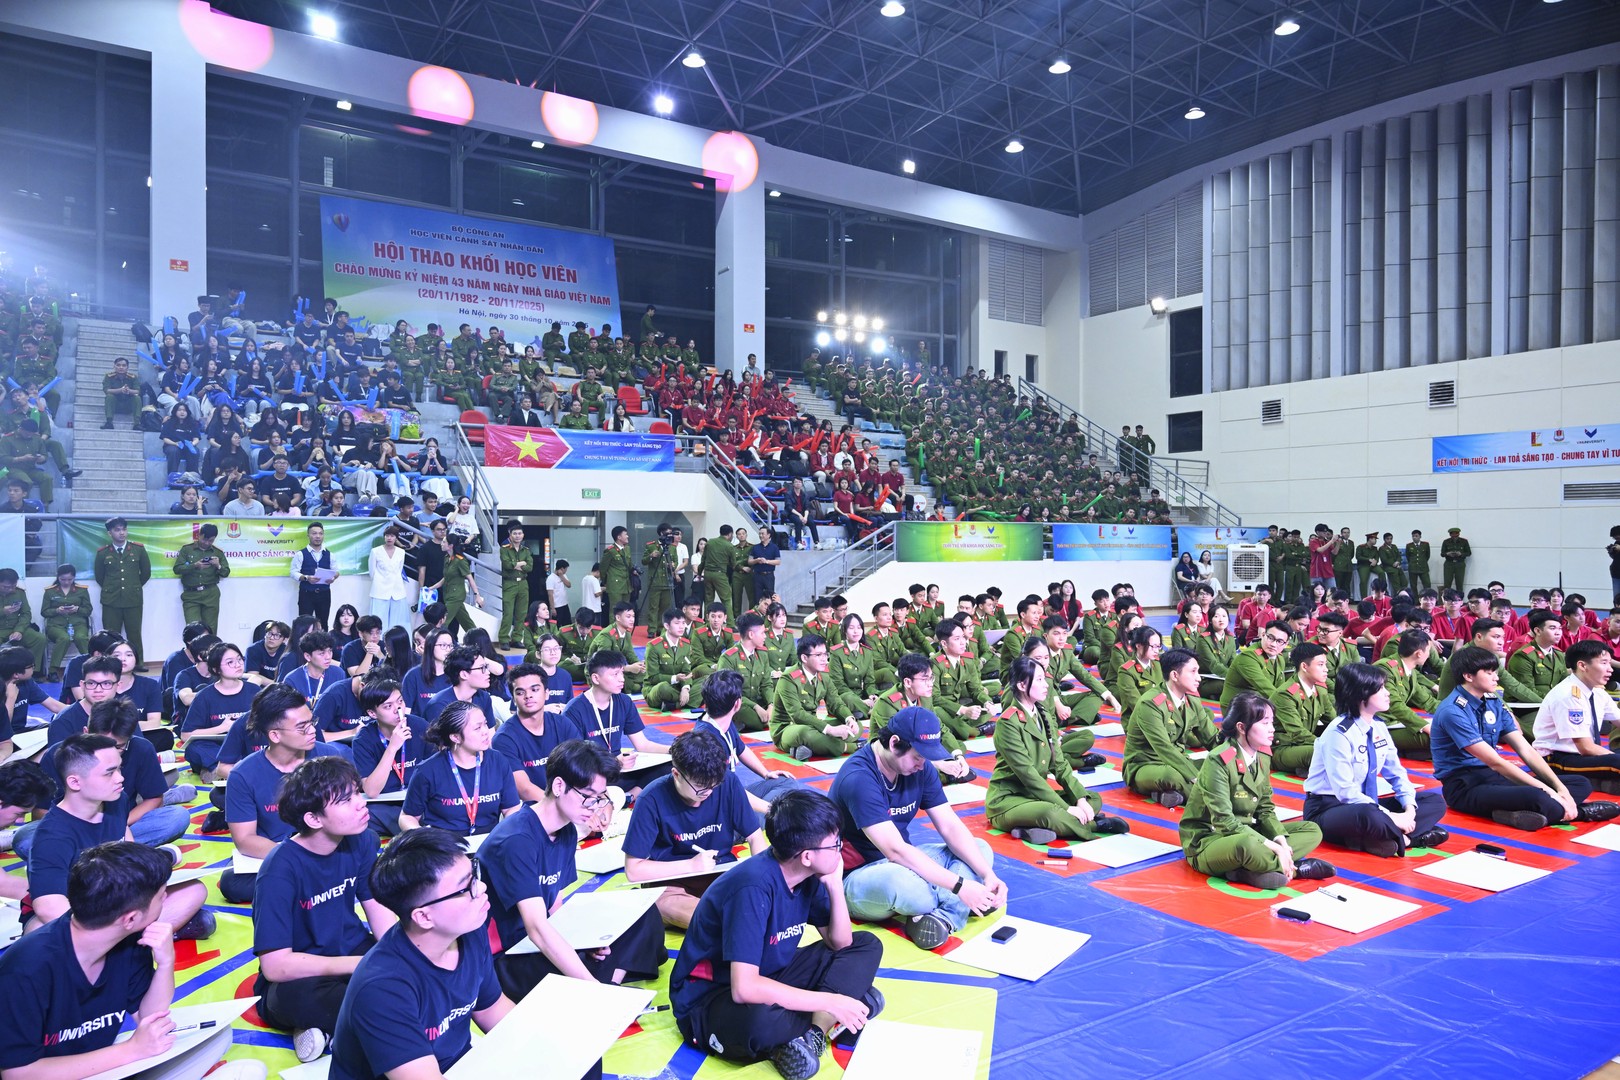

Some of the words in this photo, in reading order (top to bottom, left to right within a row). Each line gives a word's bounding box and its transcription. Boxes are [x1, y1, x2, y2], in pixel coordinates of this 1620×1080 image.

[374, 241, 404, 263] HỘI
[410, 247, 455, 268] THAO
[460, 253, 500, 274] KHỐI
[505, 260, 537, 280] HỌC
[542, 264, 578, 284] VIÊN
[334, 262, 365, 276] CHÀO
[368, 265, 402, 280] MỪNG
[404, 268, 418, 282] KỶ
[421, 272, 449, 287] NIỆM
[451, 277, 464, 288] 43
[467, 279, 491, 291] NĂM
[493, 281, 519, 294] NGÀY
[522, 285, 542, 298] NHÀ
[544, 288, 566, 301] GIÁO
[568, 290, 588, 304] VIỆT
[589, 294, 611, 307] NAM
[418, 287, 479, 304] (20/11/1982
[488, 296, 545, 312] 20/11/2025)
[571, 321, 589, 329] 25
[1461, 457, 1470, 465] TRI
[1493, 455, 1507, 464] LAN
[1522, 452, 1540, 463] SÁNG
[1541, 452, 1555, 463] TẠO
[1561, 451, 1585, 461] CHUNG
[1587, 450, 1600, 459] TAY
[1602, 447, 1610, 458] VÌ
[245, 551, 262, 560] HỌC
[262, 548, 284, 558] SÁNG
